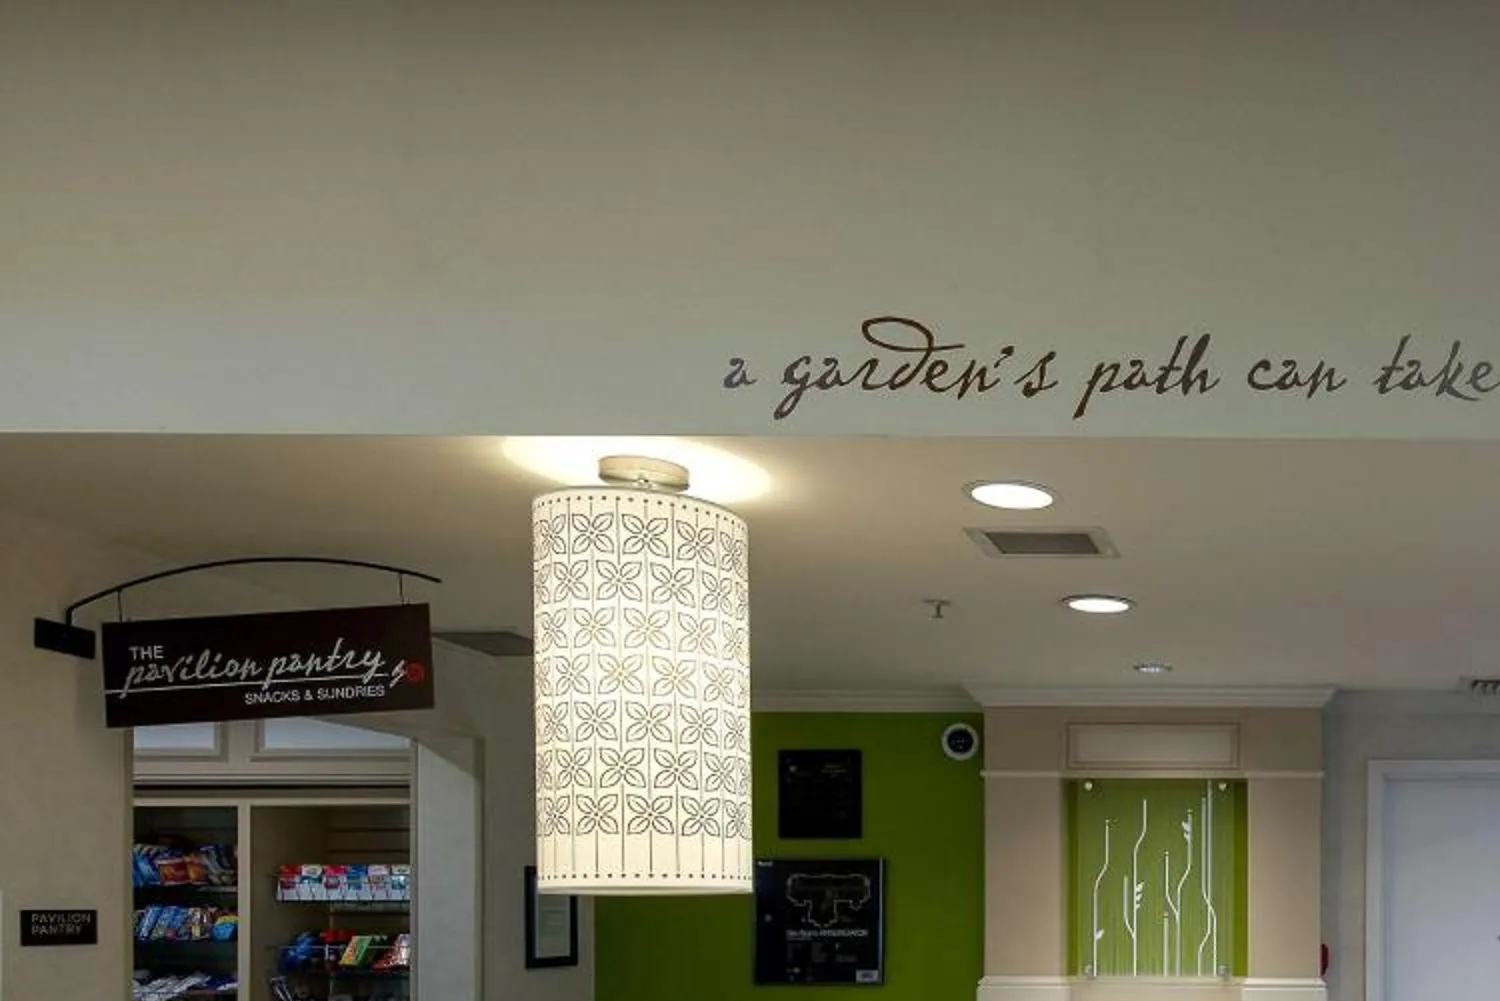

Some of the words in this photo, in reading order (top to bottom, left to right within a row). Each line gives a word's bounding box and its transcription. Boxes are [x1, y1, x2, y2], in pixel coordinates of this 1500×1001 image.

[722, 356, 758, 390] a
[772, 315, 1060, 421] garden's
[1072, 332, 1221, 421] path
[1246, 358, 1348, 401] can
[128, 645, 164, 661] THE
[119, 648, 263, 700] pavilion
[262, 637, 388, 691] pantry
[244, 688, 301, 705] SNACKS
[303, 688, 314, 701] &
[317, 684, 386, 701] SUNDRIES
[31, 913, 91, 923] PAVILION
[31, 924, 82, 935] PANTRY
